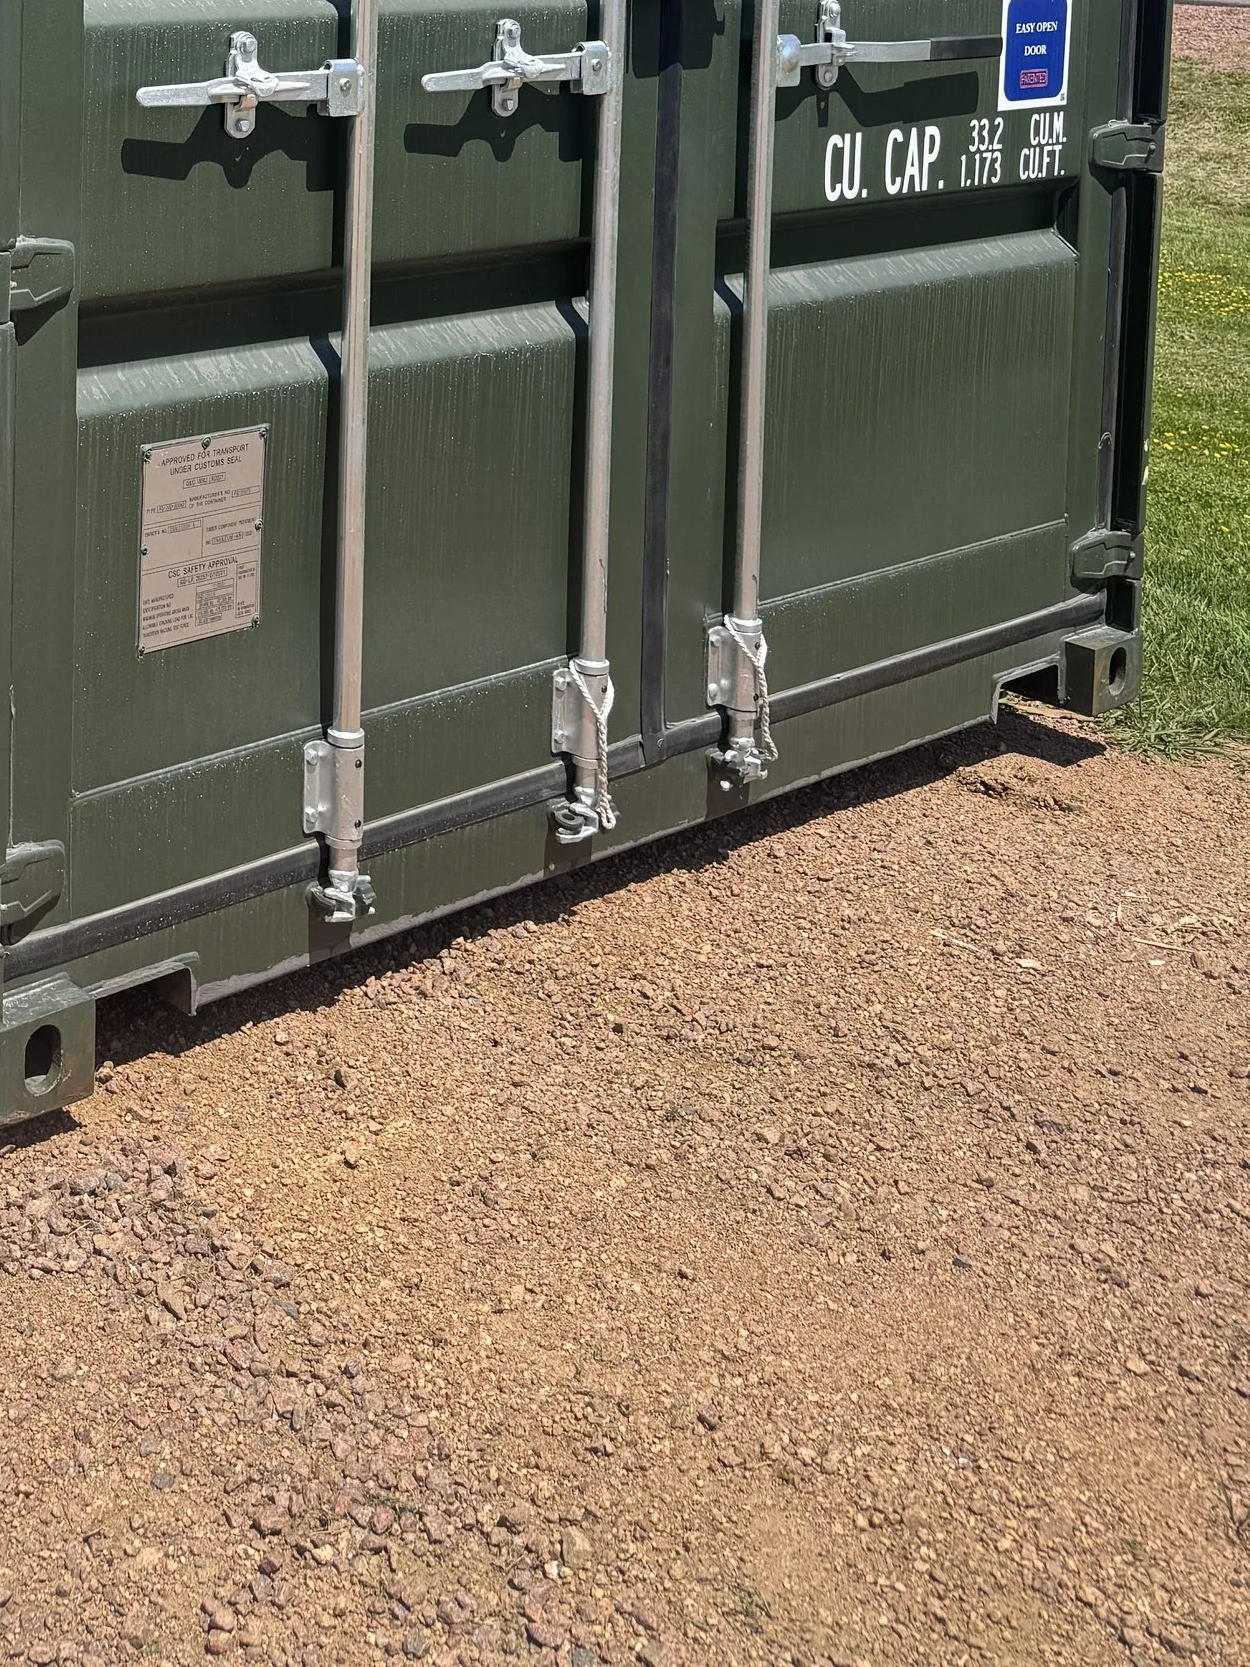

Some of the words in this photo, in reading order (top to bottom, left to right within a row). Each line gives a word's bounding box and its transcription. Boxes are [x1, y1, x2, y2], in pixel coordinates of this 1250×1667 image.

[1015, 22, 1036, 34] EASY
[1036, 21, 1058, 33] OPEN
[1024, 44, 1047, 56] DOOR
[824, 132, 868, 202] CU.
[885, 125, 945, 195] CAP.
[968, 117, 1005, 153] 33.2
[960, 151, 1002, 188] 1,173
[161, 452, 195, 467] APPROVED
[197, 450, 211, 460] FOR
[213, 443, 249, 457] TRANSPORT
[170, 465, 192, 476] UNDER
[194, 458, 225, 471] CUSTOMS
[227, 455, 242, 465] SEAL
[167, 568, 181, 578] CSC
[182, 563, 206, 575] SAFETY
[208, 556, 238, 570] APPROVAL
